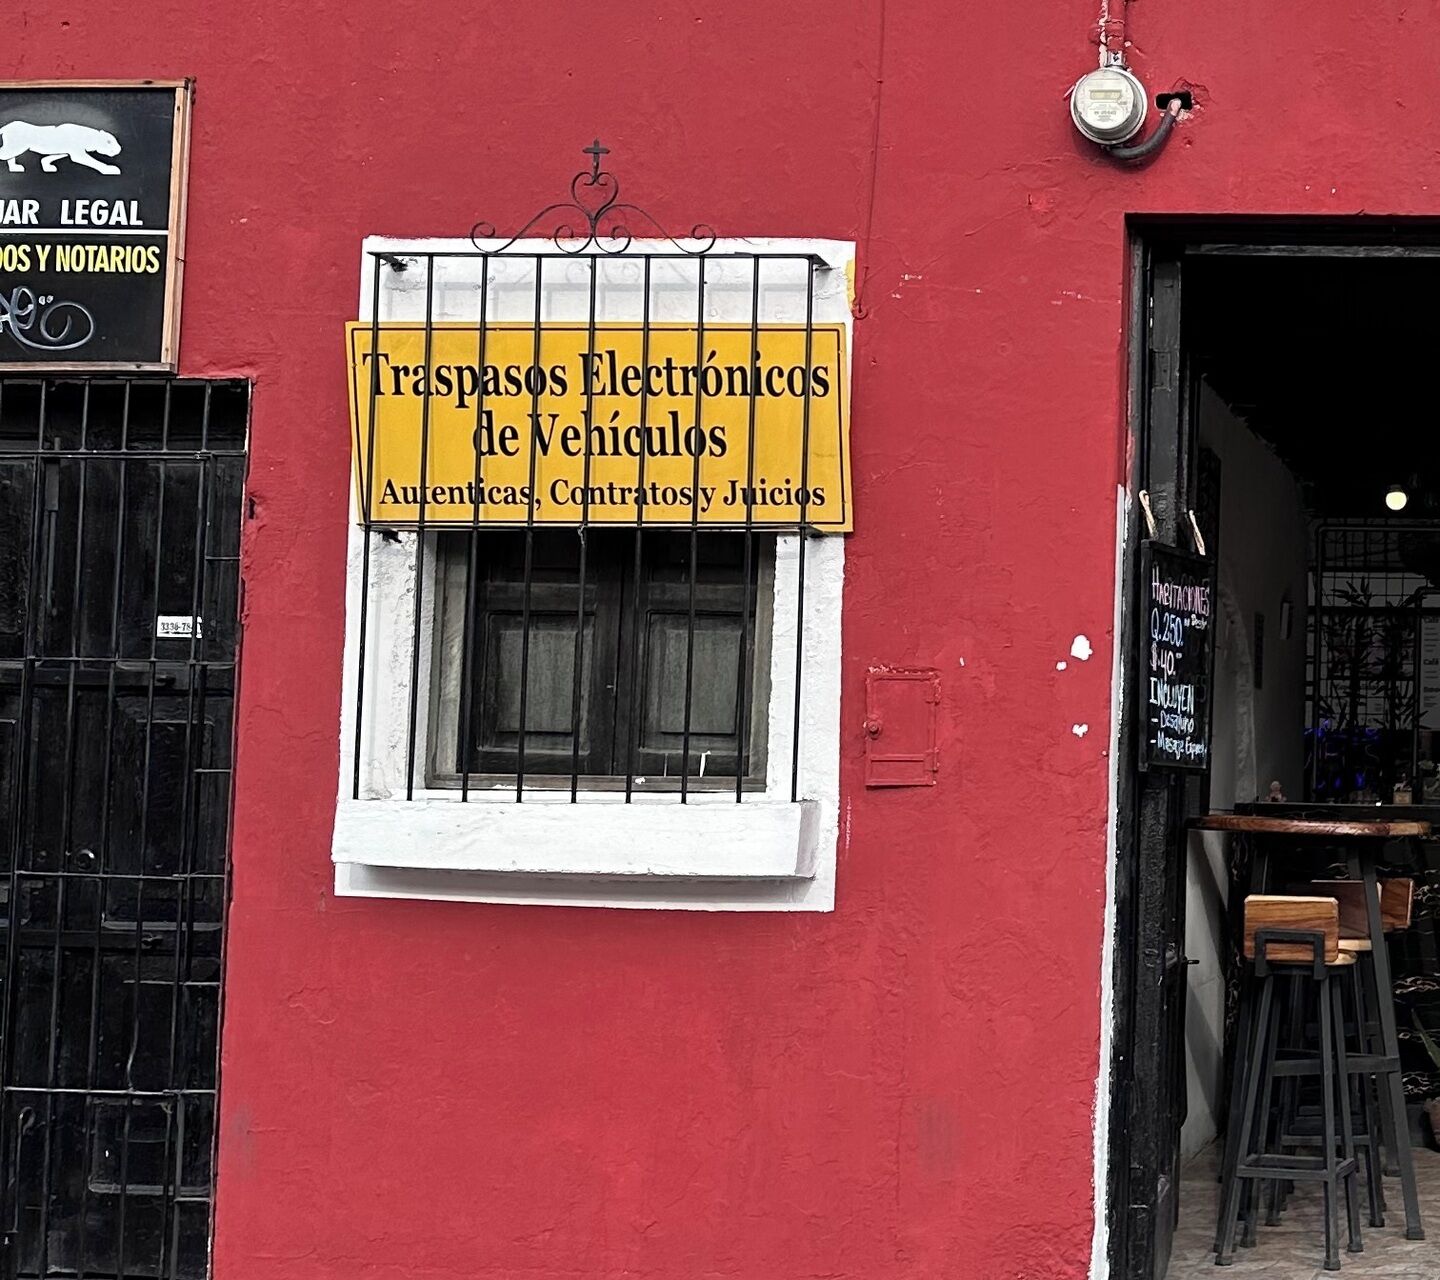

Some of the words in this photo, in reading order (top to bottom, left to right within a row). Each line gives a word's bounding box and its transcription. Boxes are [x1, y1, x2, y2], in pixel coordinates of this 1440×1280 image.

[0, 199, 40, 225] AR
[60, 199, 144, 226] LEGAL
[0, 244, 32, 272] OS
[35, 244, 51, 272] Y
[56, 245, 160, 273] NOTARIOS
[362, 352, 568, 409] Traspasos
[578, 349, 830, 398] Electrónicos
[472, 409, 520, 457] de
[527, 409, 728, 458] Vehículos
[550, 478, 693, 506] Contratos
[698, 486, 717, 513] y
[723, 477, 826, 506] Juicios
[1151, 565, 1210, 617] HABITACIONES
[1149, 676, 1195, 715] INCLUYEN
